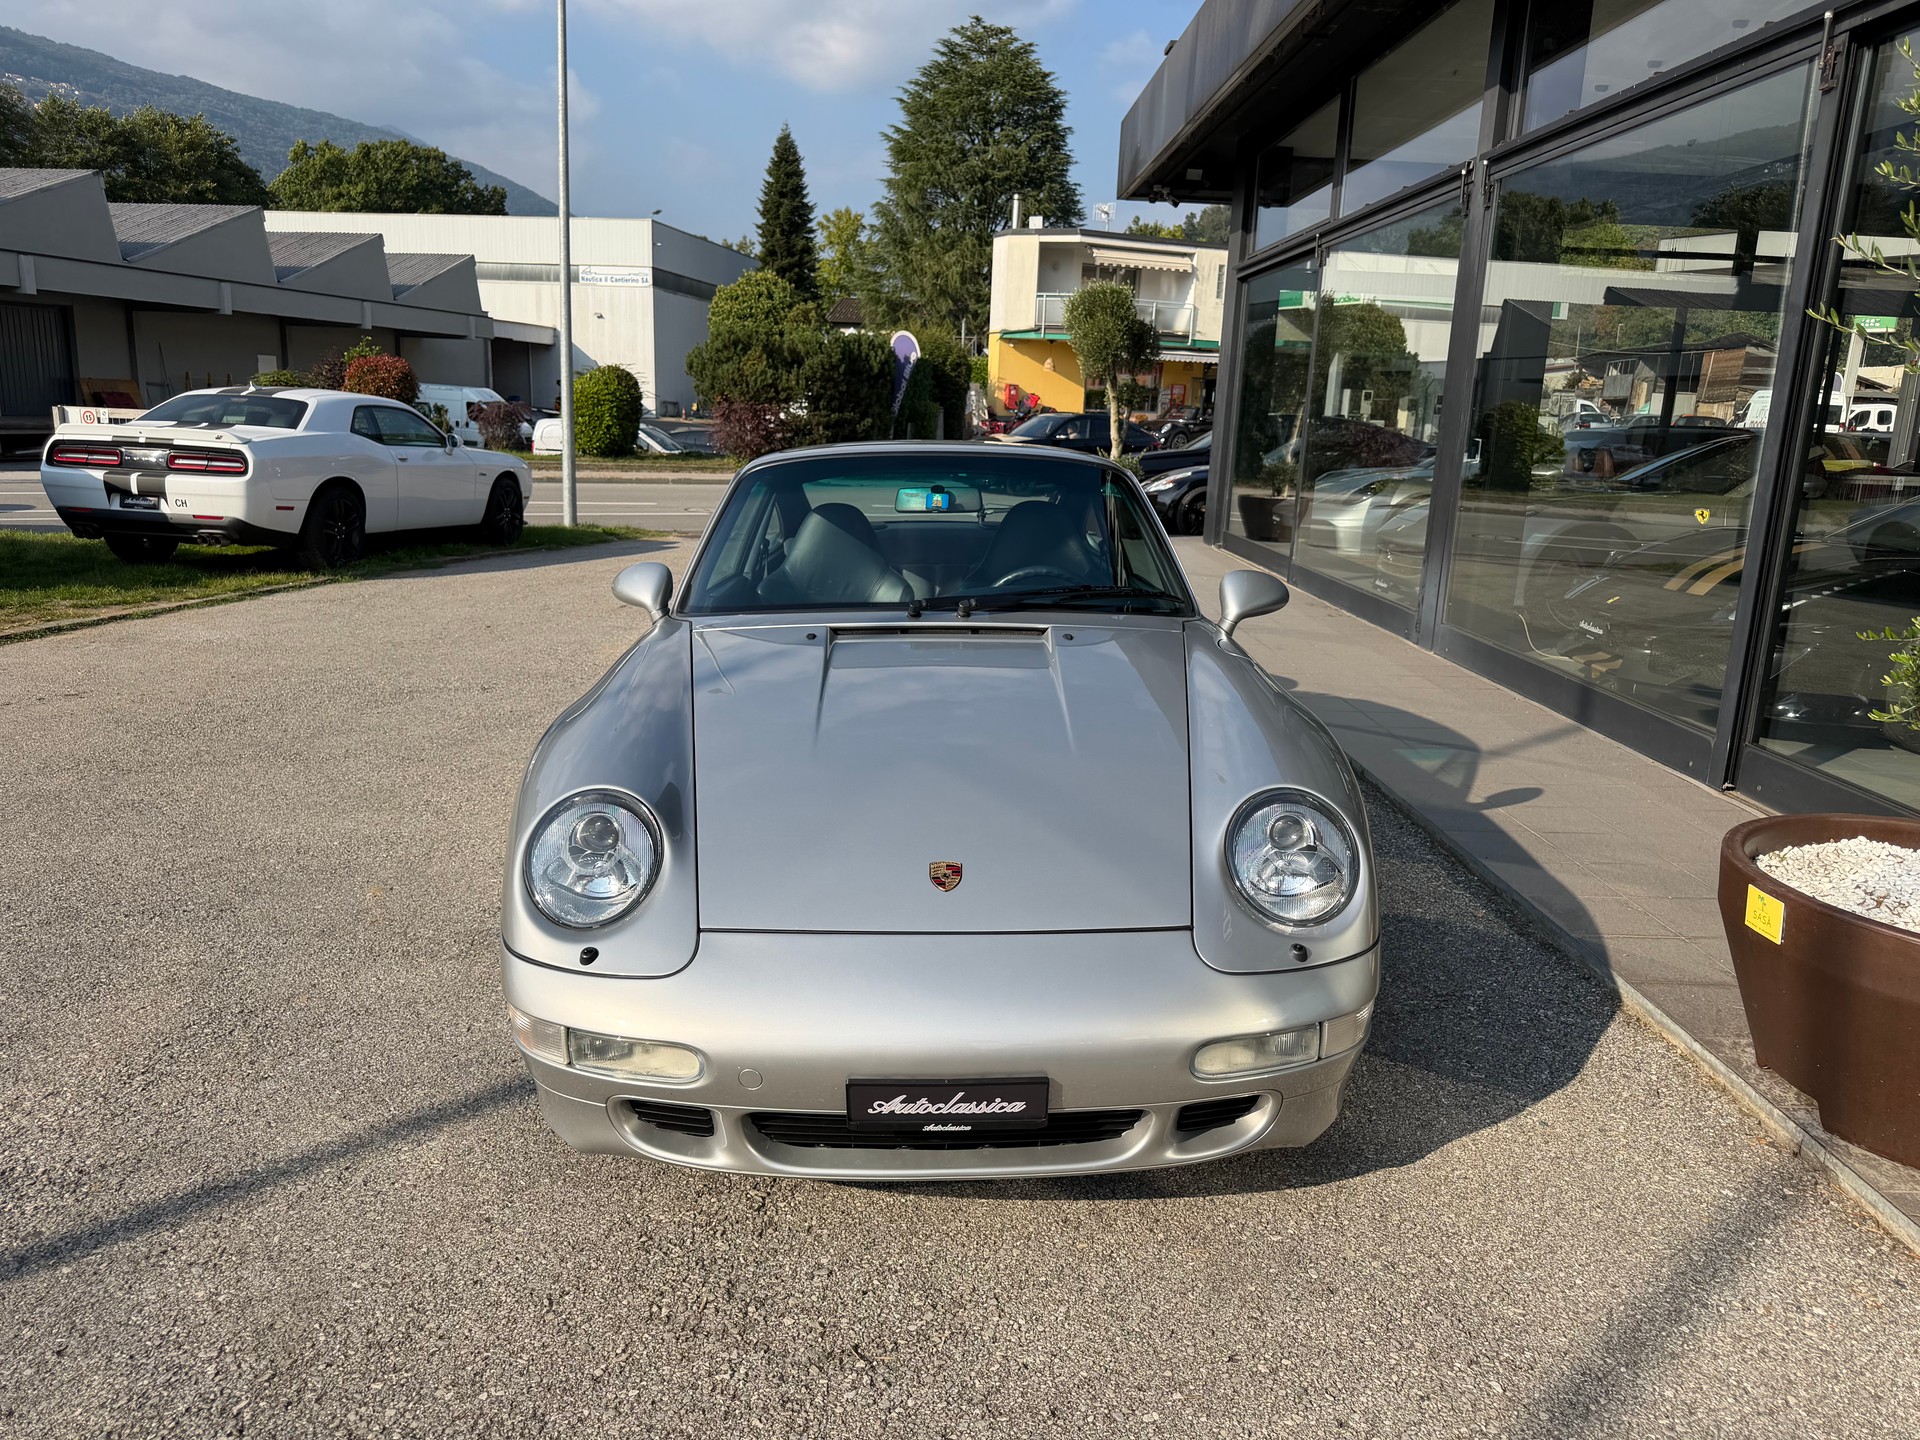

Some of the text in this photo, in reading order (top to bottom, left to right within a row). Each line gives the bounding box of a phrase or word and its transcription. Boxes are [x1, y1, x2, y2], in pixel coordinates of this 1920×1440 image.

[175, 499, 188, 508] CH
[867, 1091, 1027, 1115] Autoclassica
[922, 1123, 972, 1132] Autoclassica
